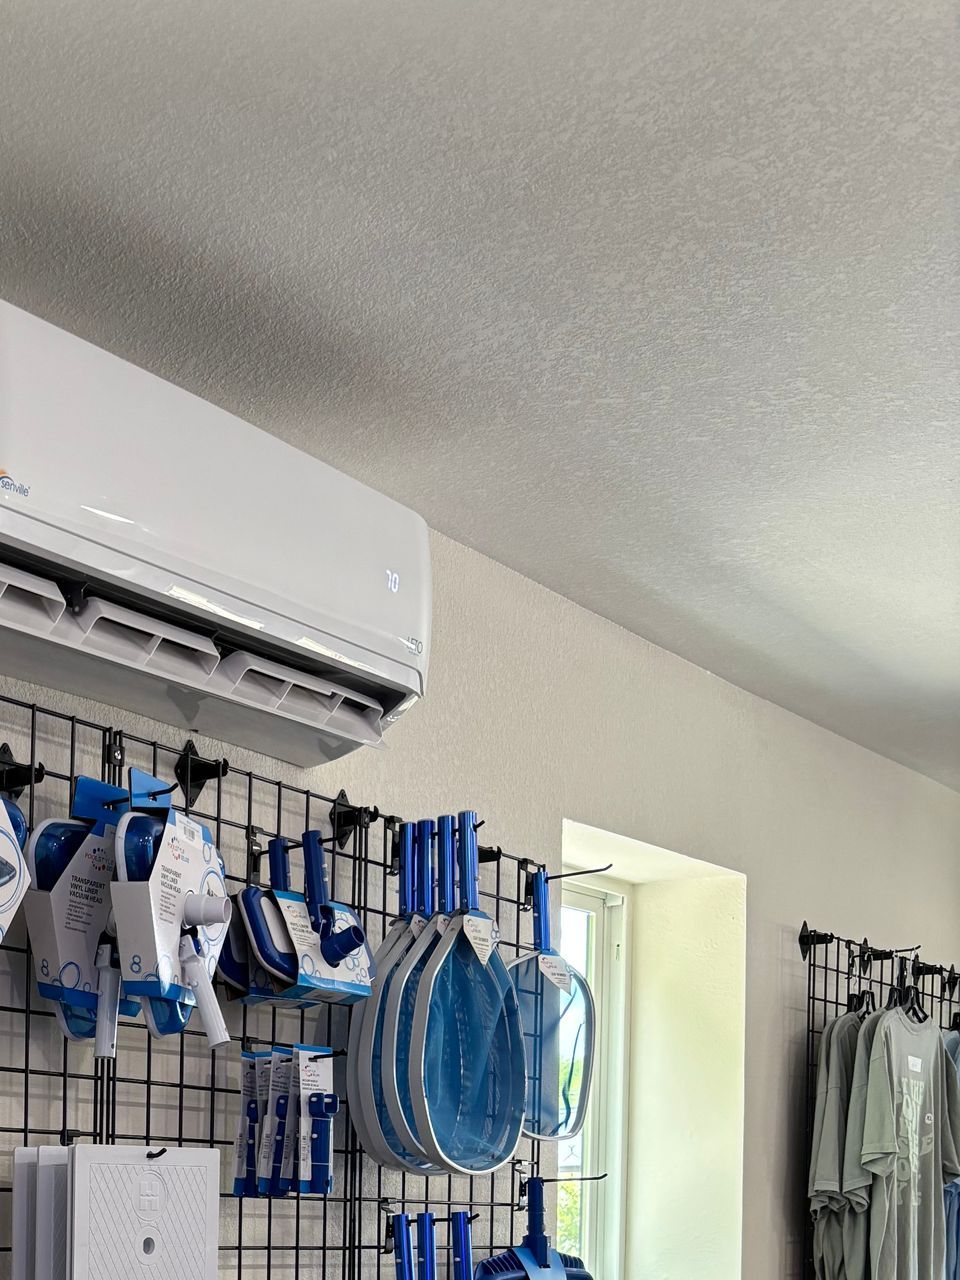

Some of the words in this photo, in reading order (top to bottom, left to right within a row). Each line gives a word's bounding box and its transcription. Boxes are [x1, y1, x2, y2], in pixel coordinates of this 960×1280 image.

[0, 479, 29, 497] senville
[70, 882, 83, 892] VINYL
[84, 886, 99, 895] LINER
[71, 875, 106, 890] TRANSPARENT
[69, 890, 89, 900] VACUUM
[89, 895, 103, 904] HEAD
